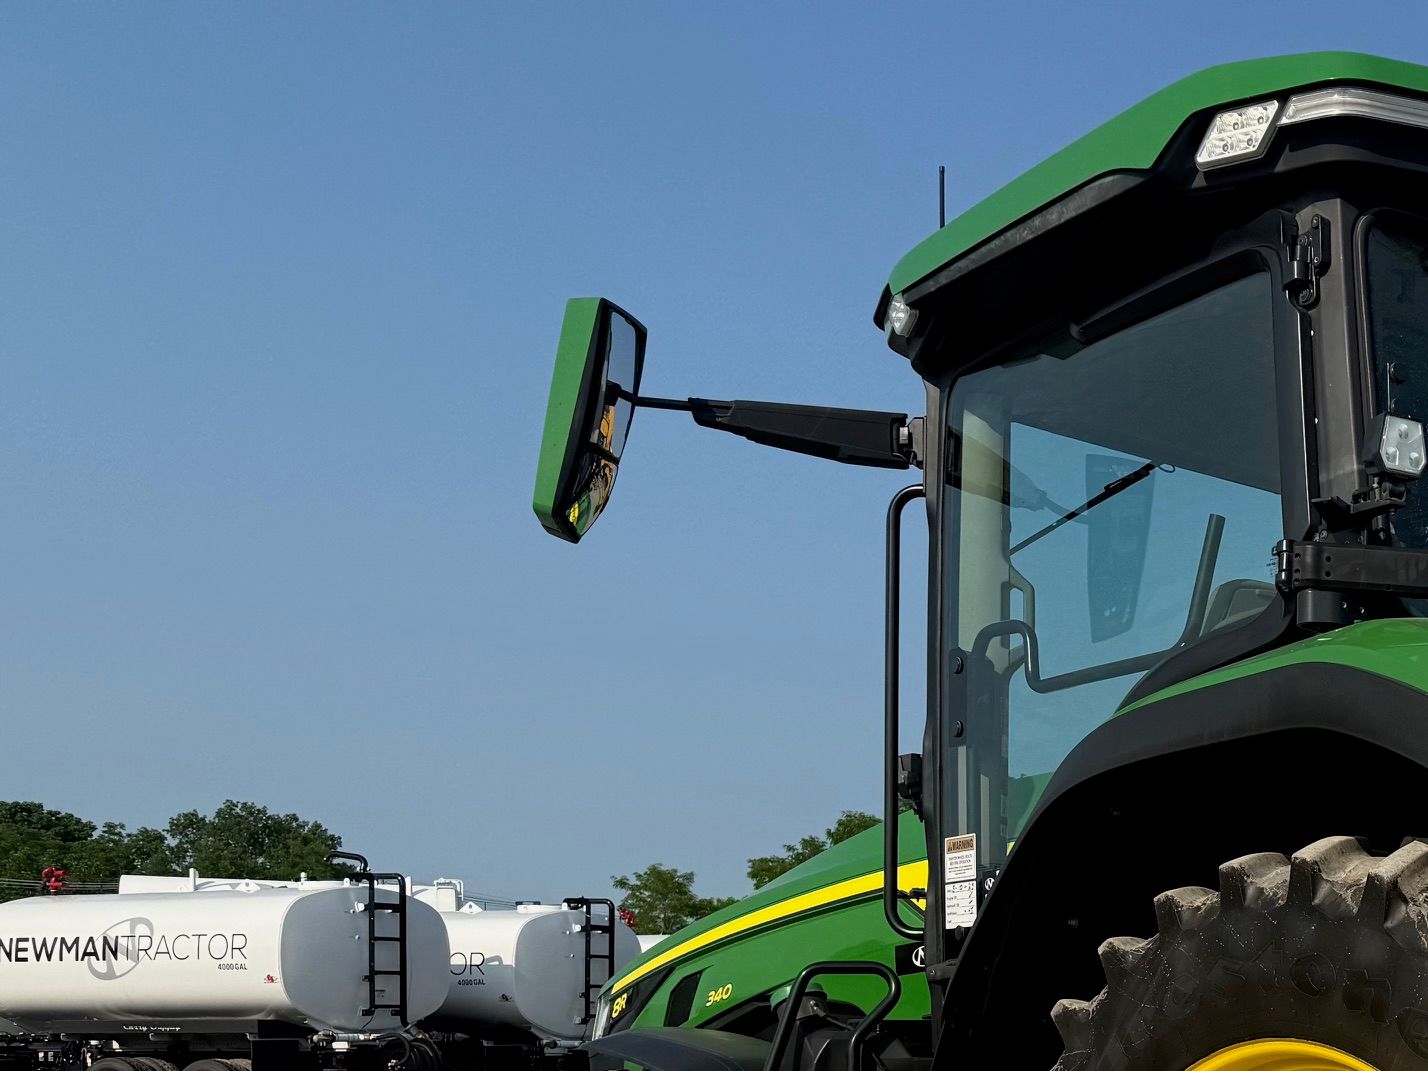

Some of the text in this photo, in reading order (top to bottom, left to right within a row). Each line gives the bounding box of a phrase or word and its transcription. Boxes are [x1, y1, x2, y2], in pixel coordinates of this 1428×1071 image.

[217, 963, 248, 971] 4000 GAL
[611, 992, 628, 1019] 8R
[705, 983, 733, 1007] 340
